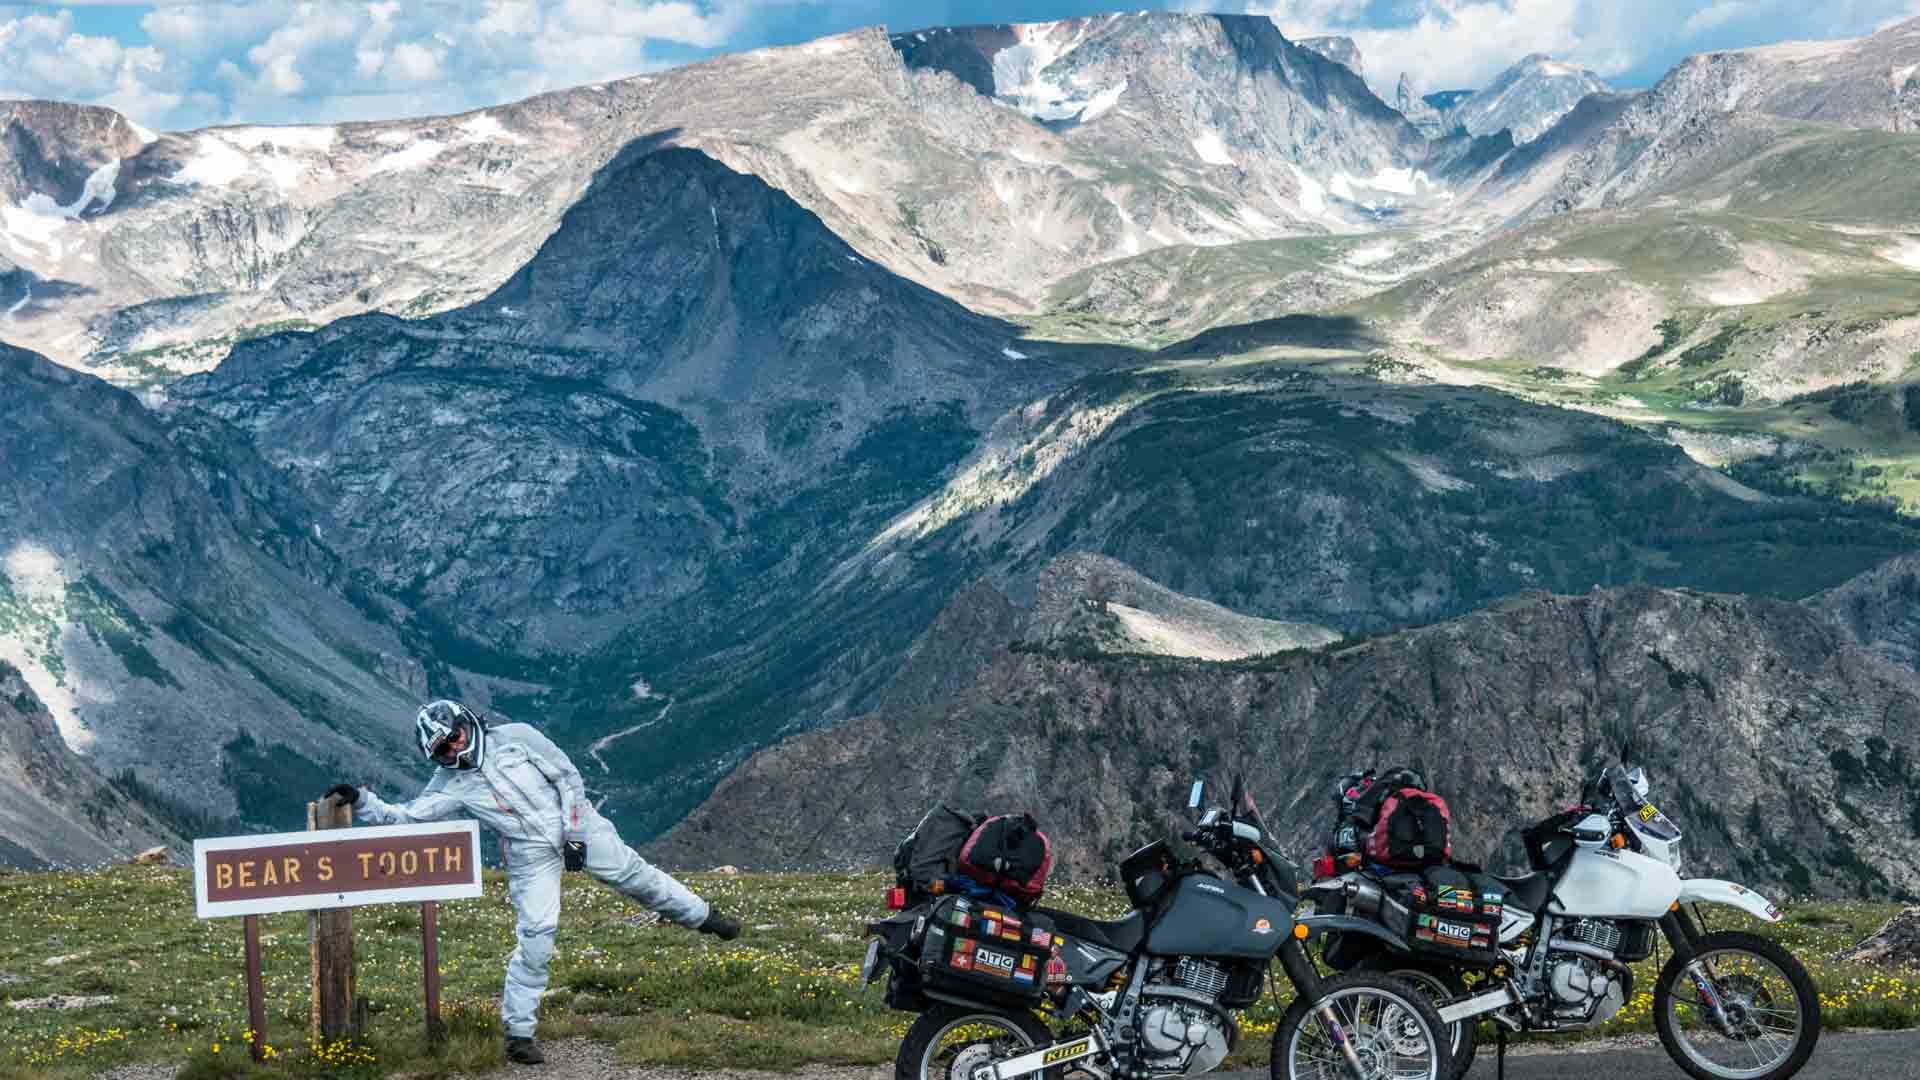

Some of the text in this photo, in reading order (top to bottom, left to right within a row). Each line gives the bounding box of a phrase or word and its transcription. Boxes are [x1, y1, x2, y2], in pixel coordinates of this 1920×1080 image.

[357, 847, 464, 880] TOOTH
[1438, 922, 1470, 939] ATG
[977, 948, 1014, 968] ATG
[1046, 1043, 1086, 1063] Klim
